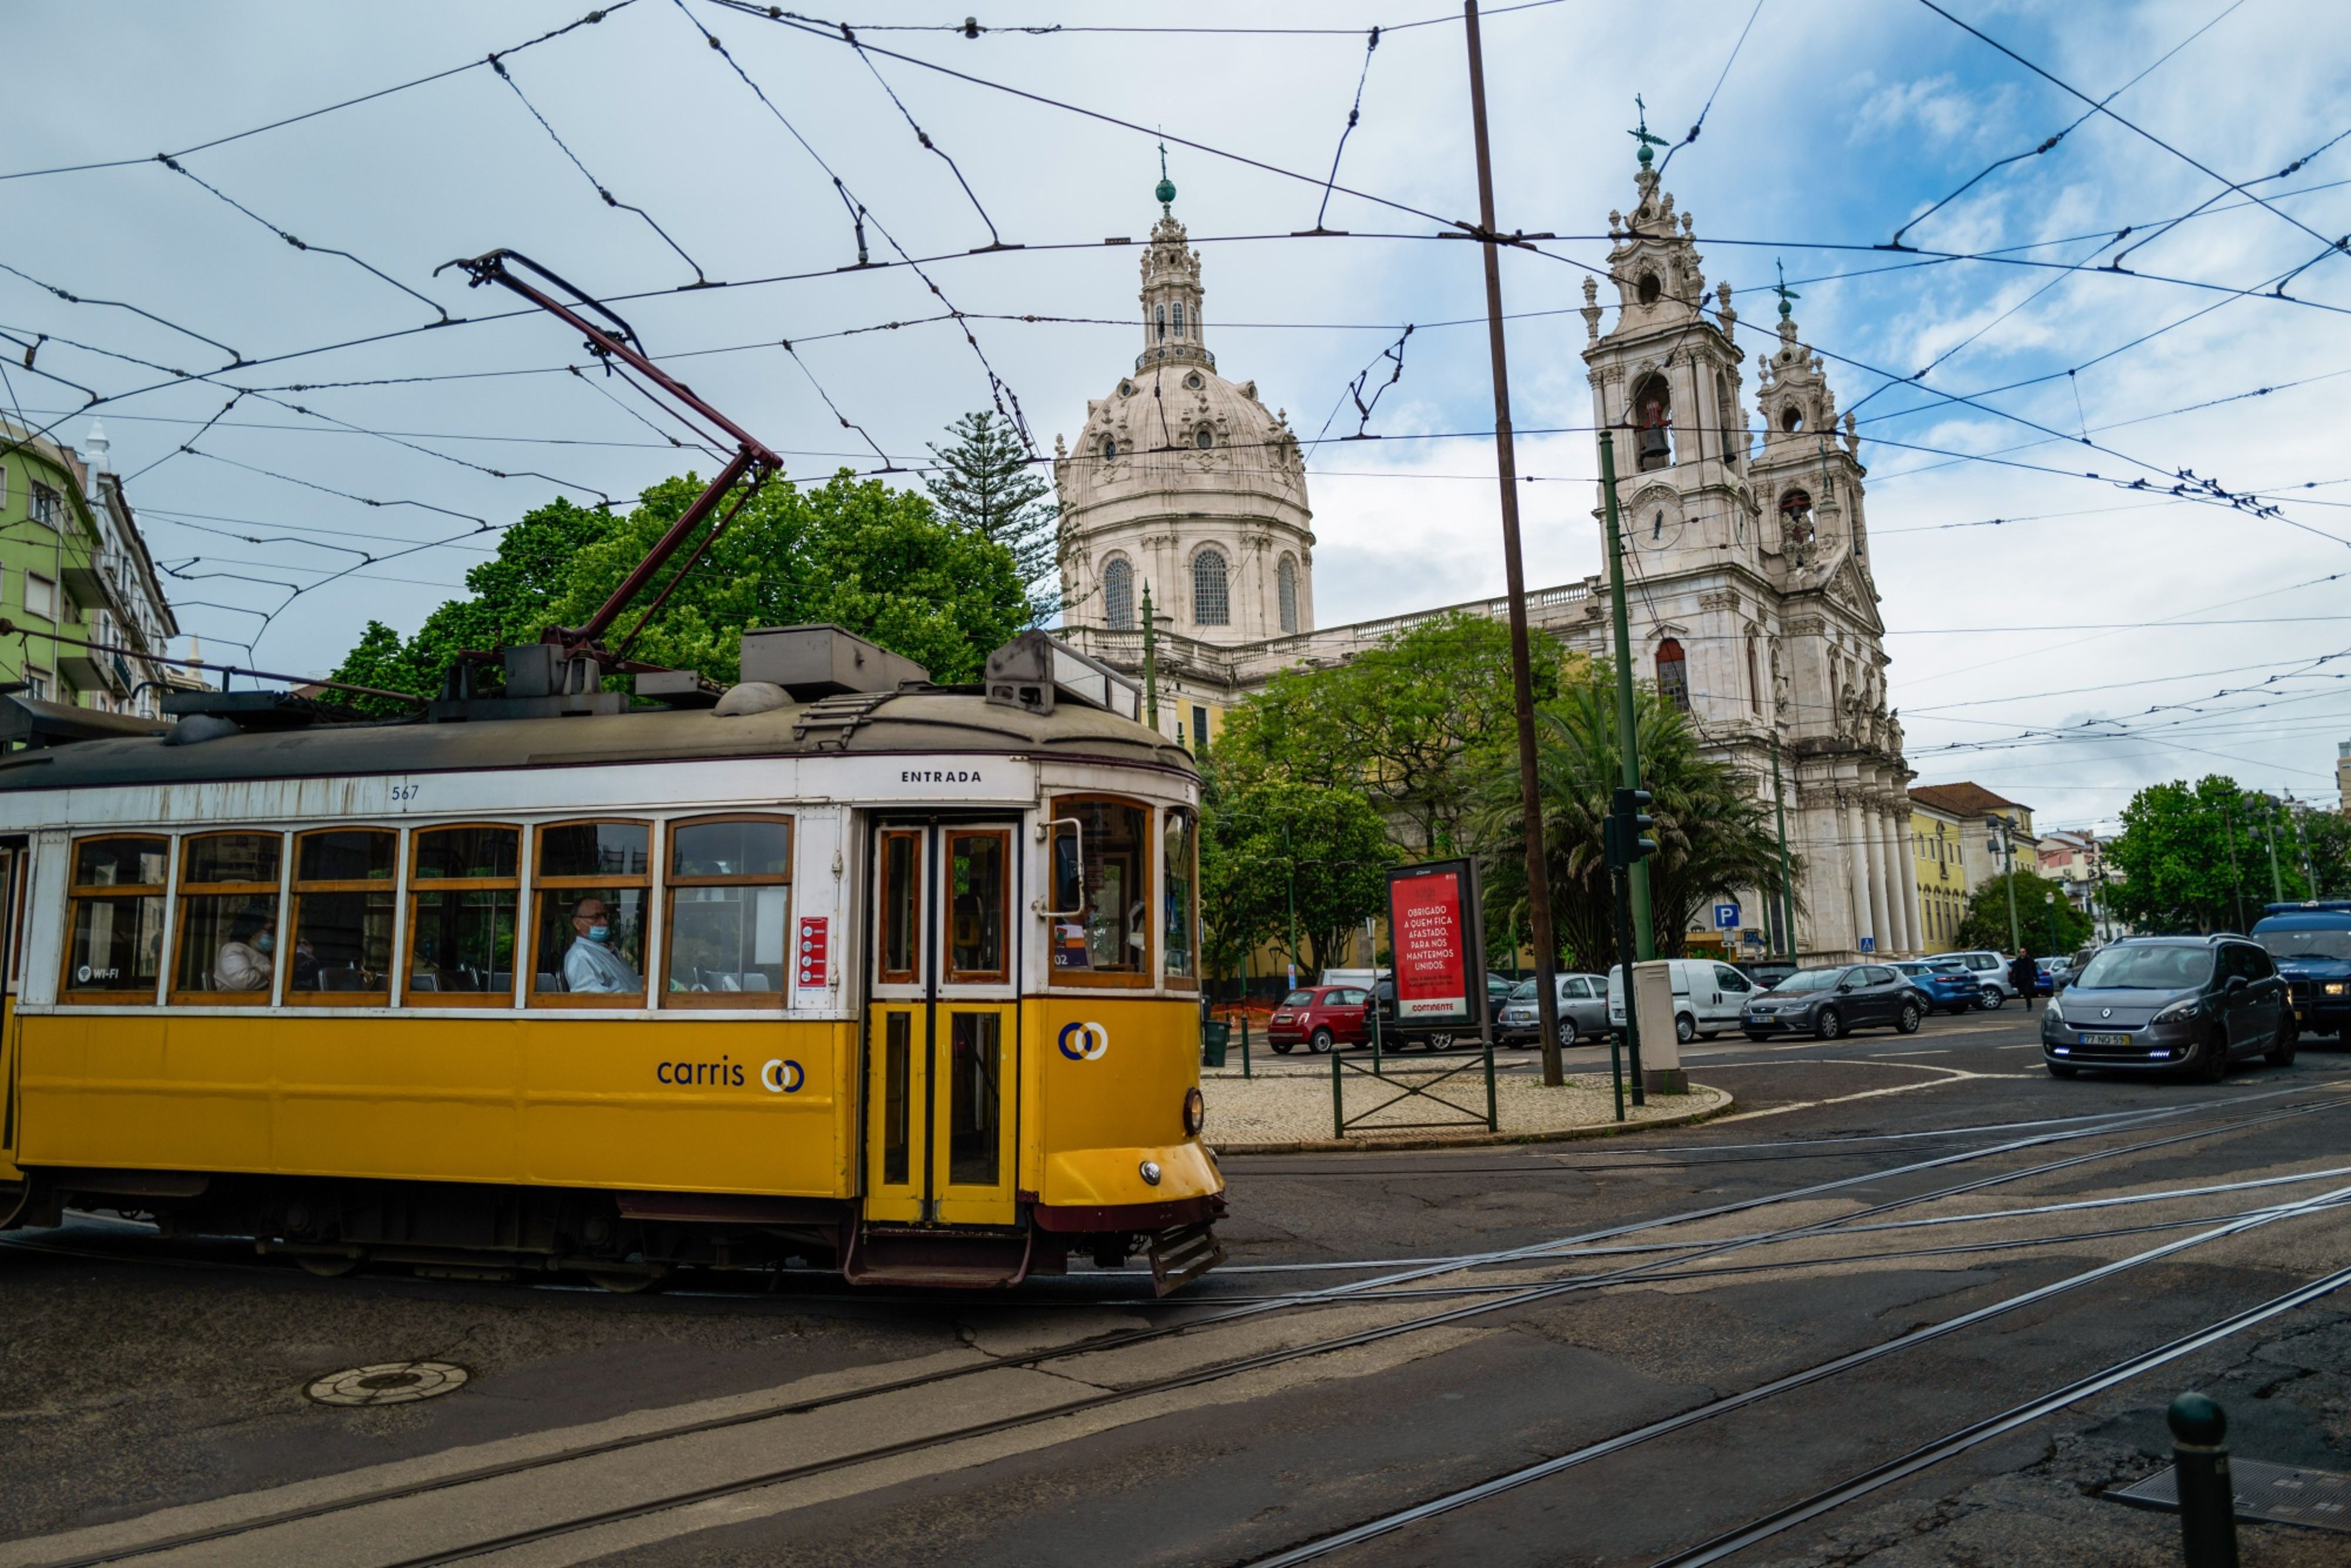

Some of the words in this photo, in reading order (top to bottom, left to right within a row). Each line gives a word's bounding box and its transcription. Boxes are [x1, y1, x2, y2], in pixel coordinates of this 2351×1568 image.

[902, 771, 982, 782] ENTRADA
[392, 785, 419, 800] 567
[1408, 906, 1446, 917] OBRIGADO
[1720, 908, 1733, 924] P
[1411, 918, 1432, 929] QUEM
[1434, 916, 1452, 926] FICA
[1411, 941, 1430, 949] PARA
[1431, 939, 1447, 947] NOS
[1406, 949, 1454, 960] MANTERMOS
[1415, 961, 1445, 970] UNIDOS.
[93, 968, 119, 979] WI-FI
[1412, 1003, 1454, 1011] CONTINENTE
[657, 1055, 745, 1086] carris
